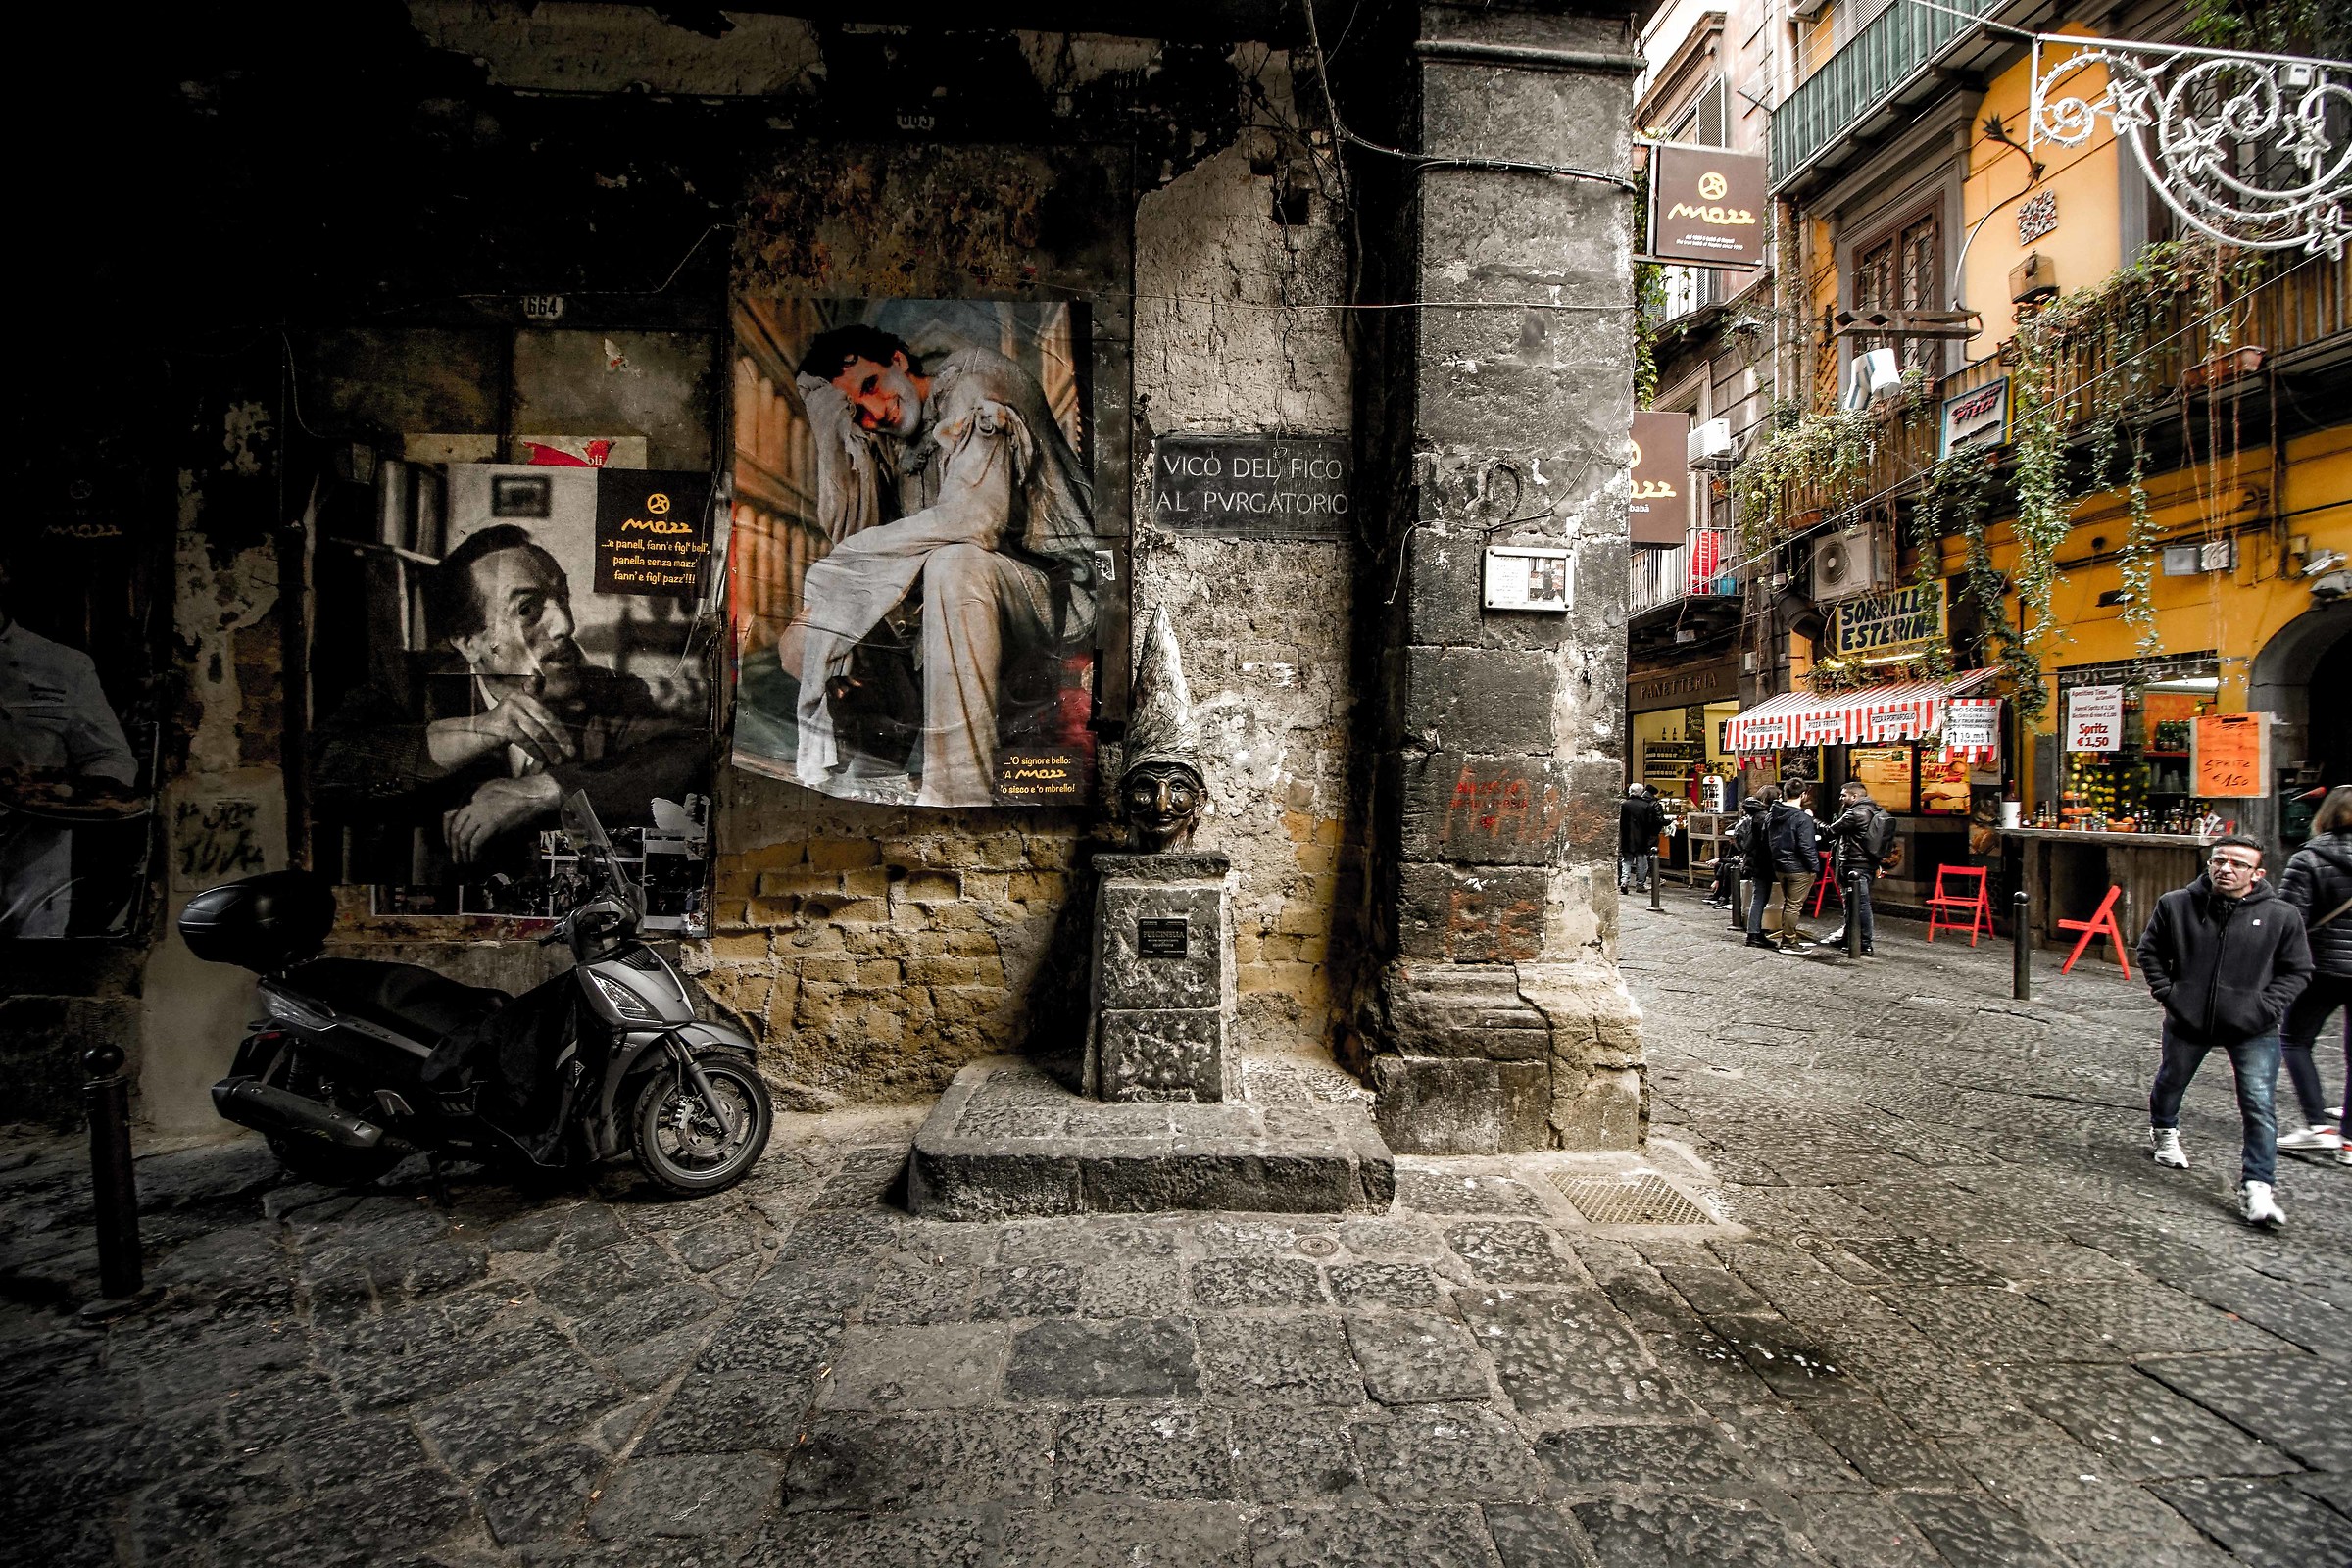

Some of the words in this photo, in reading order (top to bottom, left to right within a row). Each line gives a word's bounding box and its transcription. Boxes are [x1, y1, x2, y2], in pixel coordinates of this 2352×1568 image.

[527, 296, 558, 316] 664
[1163, 454, 1222, 476] VICO
[1233, 458, 1280, 478] DEL
[1291, 458, 1343, 480] FICO
[1155, 491, 1189, 513] AL
[1203, 491, 1348, 514] PVRGATORIO
[612, 555, 645, 566] panella
[647, 559, 672, 567] senza
[1841, 586, 1939, 626] SORBILL
[1841, 614, 1937, 651] ESTERIN
[1641, 672, 1717, 699] PANETTERIA
[2079, 723, 2108, 736] Spritz
[1021, 757, 1050, 767] signore
[1052, 756, 1071, 764] bello:
[1008, 785, 1029, 794] sisco
[1045, 784, 1075, 793] mbrello!
